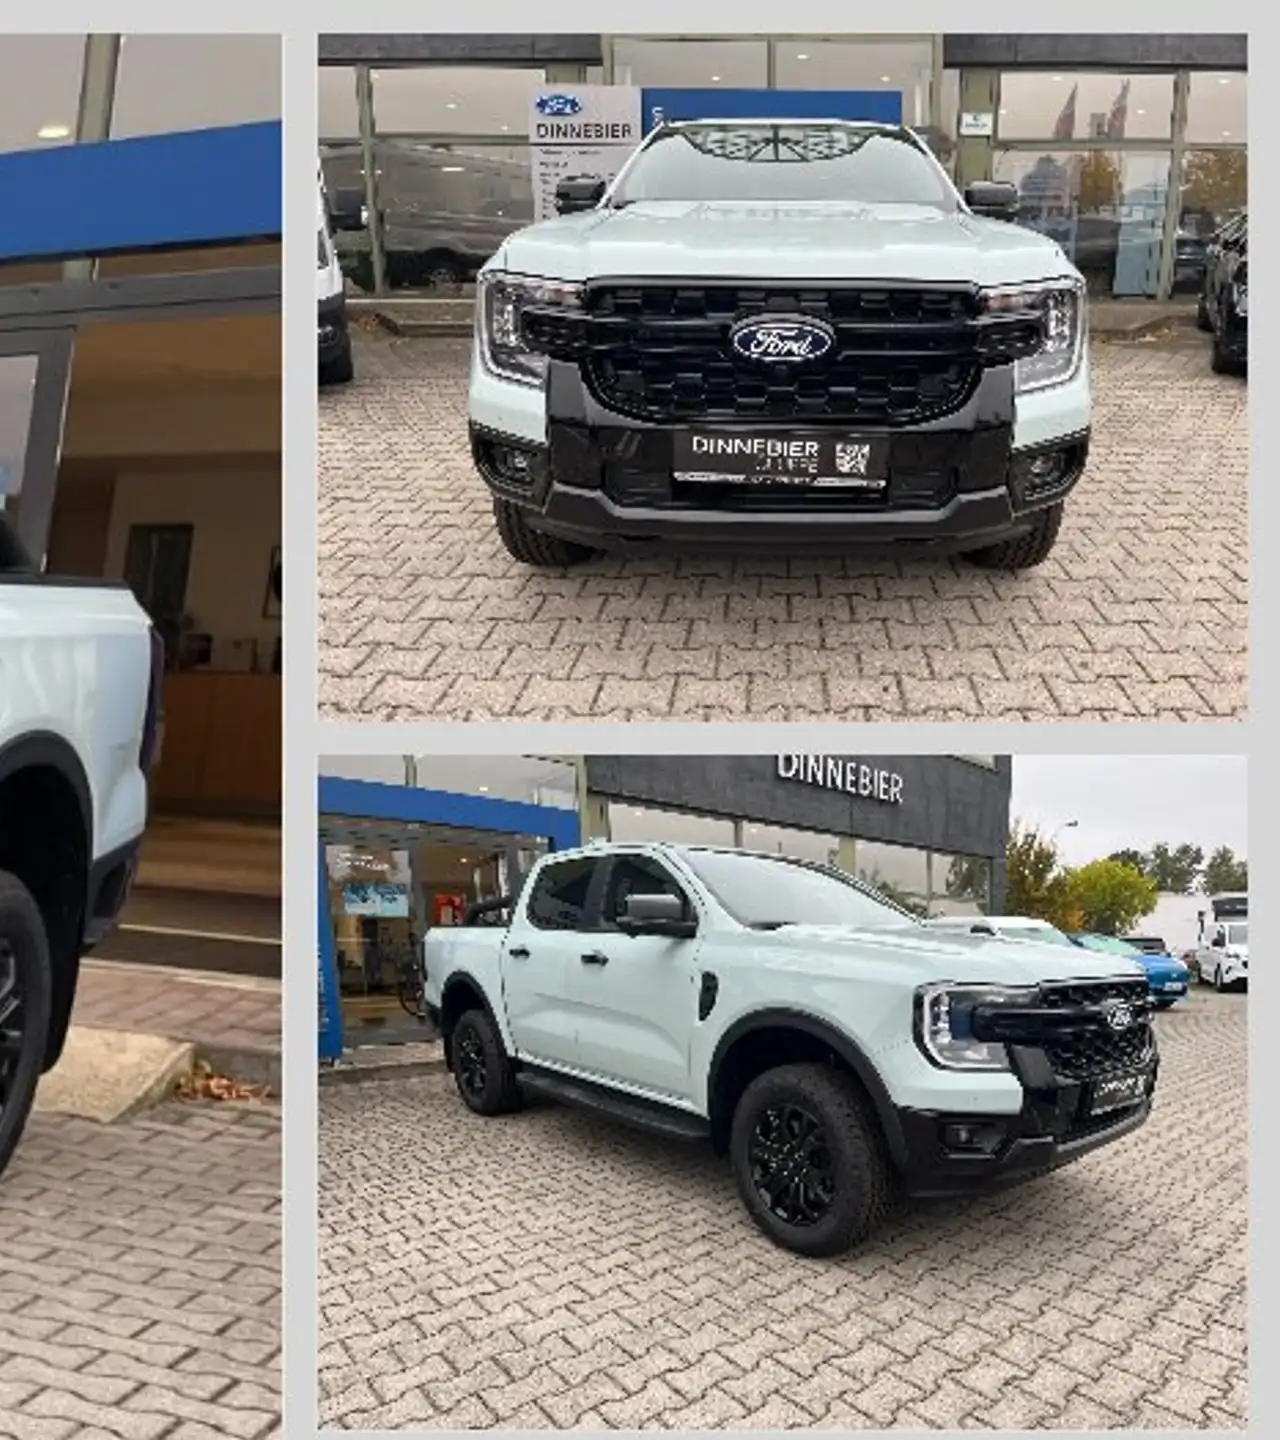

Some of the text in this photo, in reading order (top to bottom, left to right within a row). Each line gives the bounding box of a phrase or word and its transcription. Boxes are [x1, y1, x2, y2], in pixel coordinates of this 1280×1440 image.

[534, 123, 632, 139] DINNEBIER
[749, 328, 812, 356] Ford
[692, 436, 820, 457] DINNEBIER
[777, 752, 904, 804] DINNEBIER
